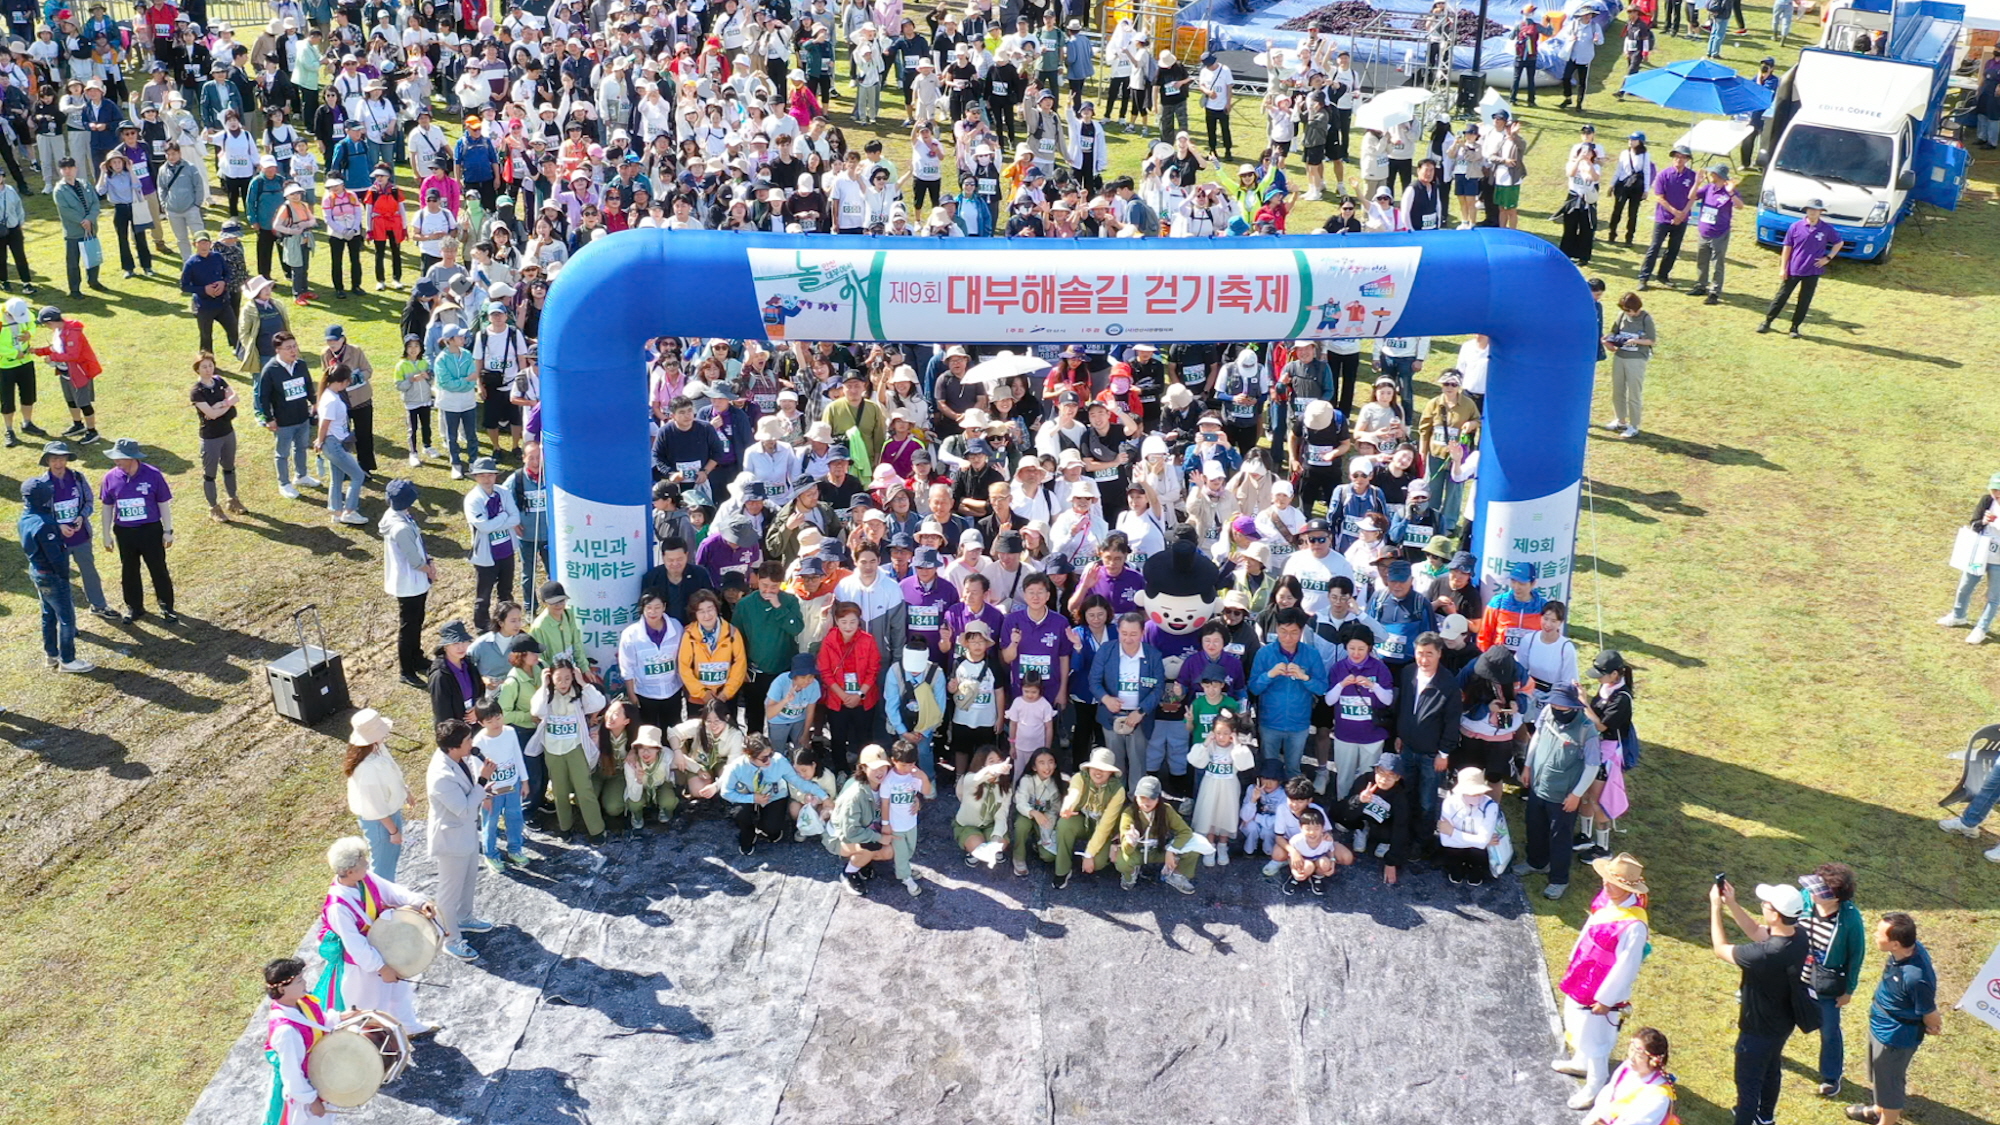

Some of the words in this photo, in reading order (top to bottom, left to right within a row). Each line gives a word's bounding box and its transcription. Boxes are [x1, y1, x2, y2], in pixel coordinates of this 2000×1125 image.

[1847, 106, 1882, 118] COFFEE
[889, 280, 942, 304] 제9회
[947, 275, 1129, 315] 대부해솔길
[1144, 274, 1289, 315] 걷기축제
[121, 508, 145, 517] 1308
[1407, 533, 1430, 544] 1117
[572, 537, 628, 558] 시민과
[1513, 537, 1555, 554] 제9회
[565, 560, 637, 580] 함께하는
[1487, 554, 1570, 579] 대부솔길
[1302, 579, 1326, 590] 0761
[911, 616, 935, 625] 1341
[648, 662, 673, 674] 1311
[701, 671, 725, 681] 1146
[1343, 705, 1369, 715] 1143
[550, 724, 576, 734] 1503
